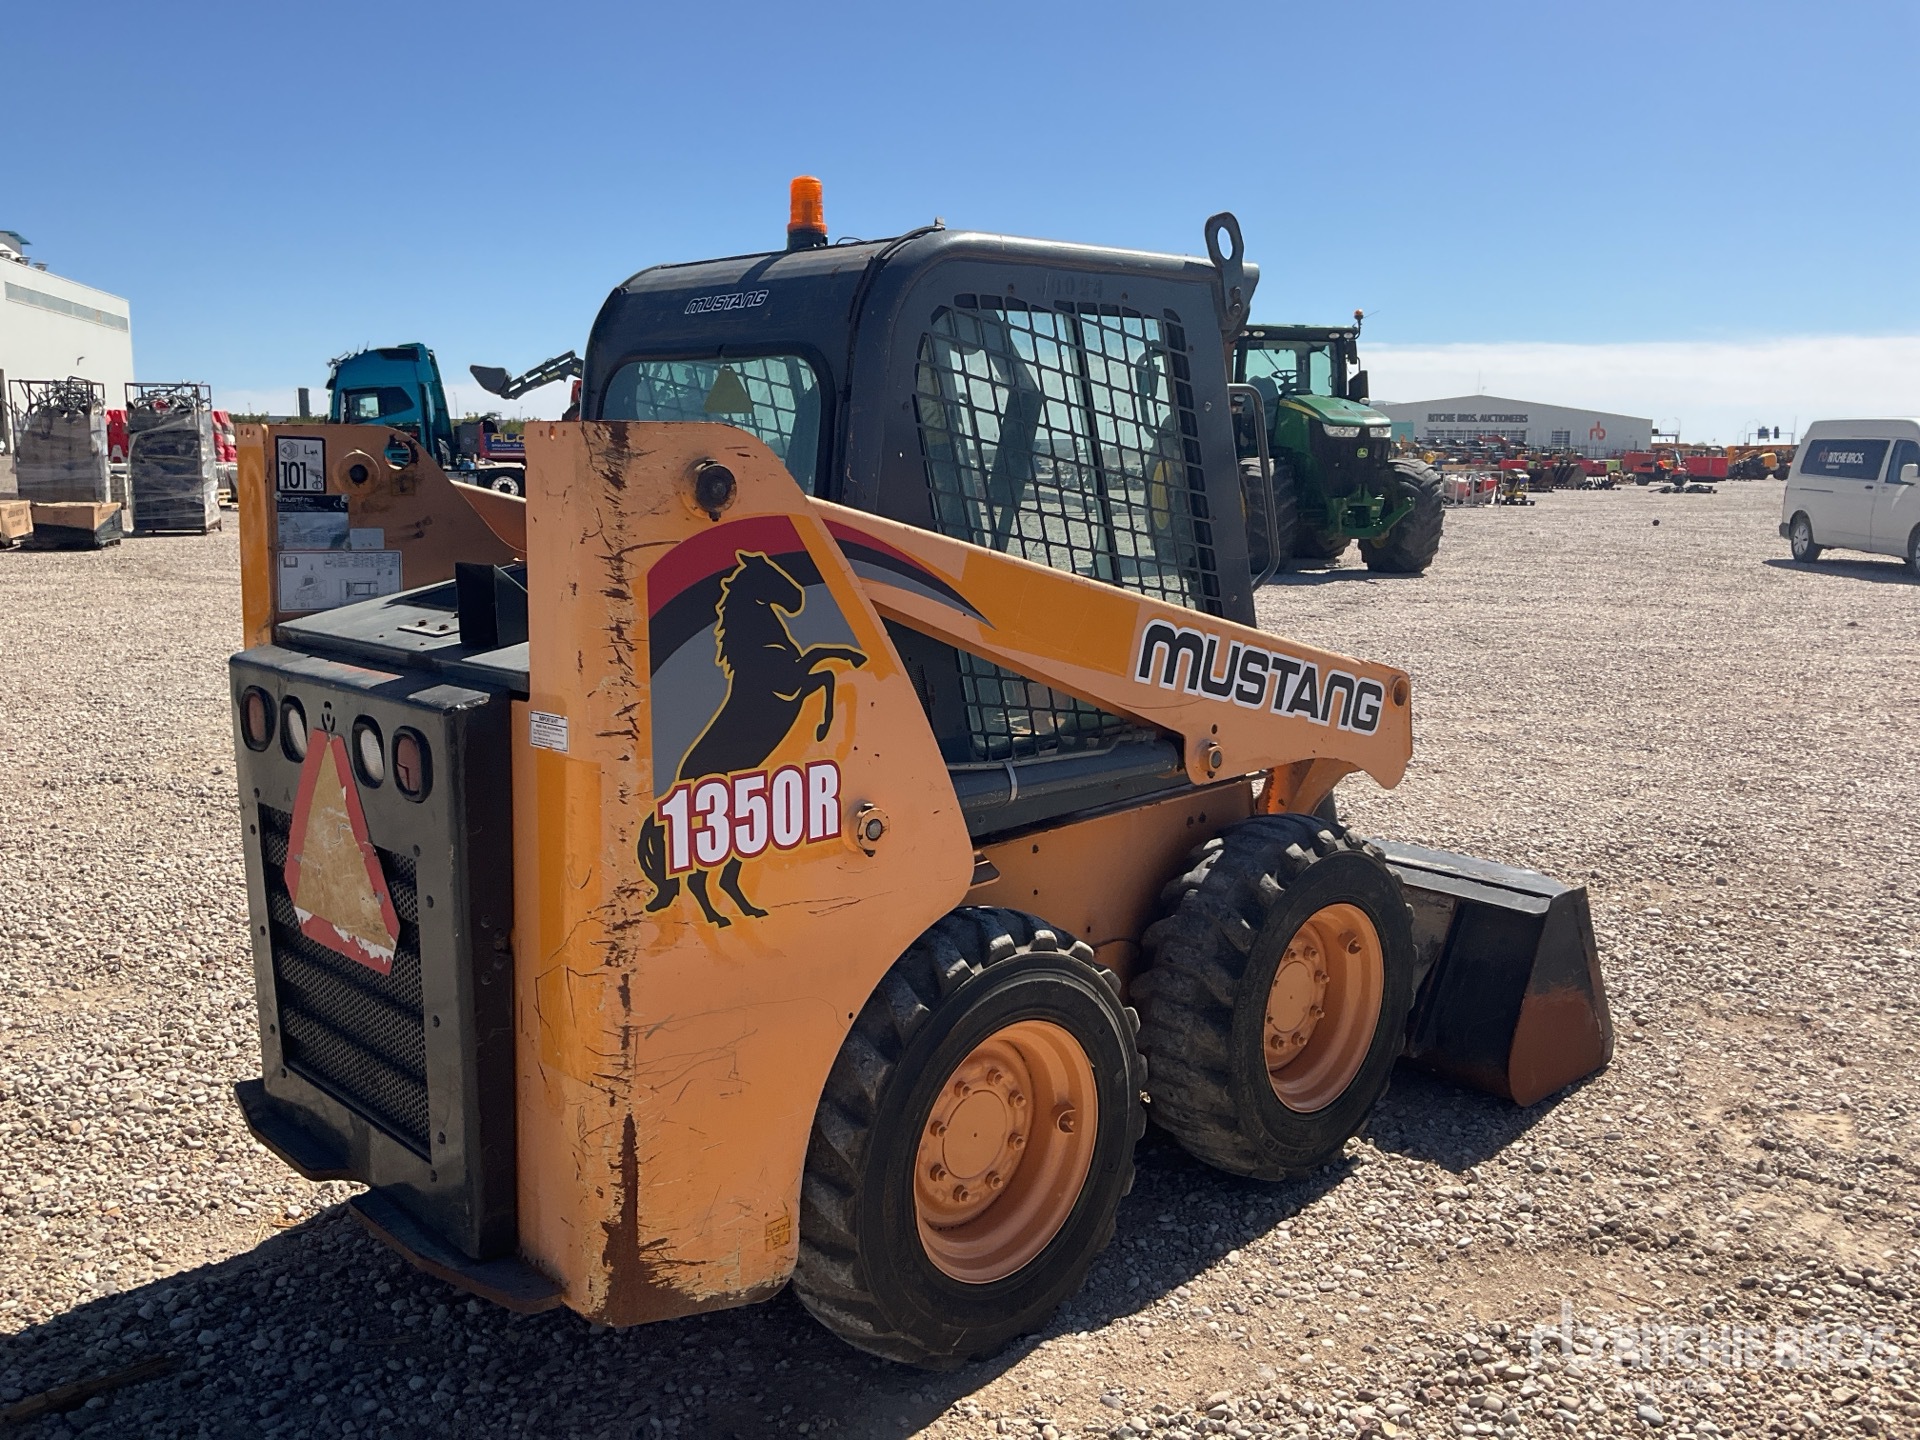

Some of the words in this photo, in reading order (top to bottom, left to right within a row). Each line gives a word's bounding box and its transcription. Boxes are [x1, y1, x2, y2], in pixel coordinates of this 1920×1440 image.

[684, 289, 769, 315] MUSTANG
[1427, 413, 1456, 423] RITCHIE
[1479, 414, 1529, 423] AUCTIONEERS
[280, 461, 307, 490] 101
[1134, 618, 1386, 736] MUSTANG
[658, 758, 842, 875] 1350R
